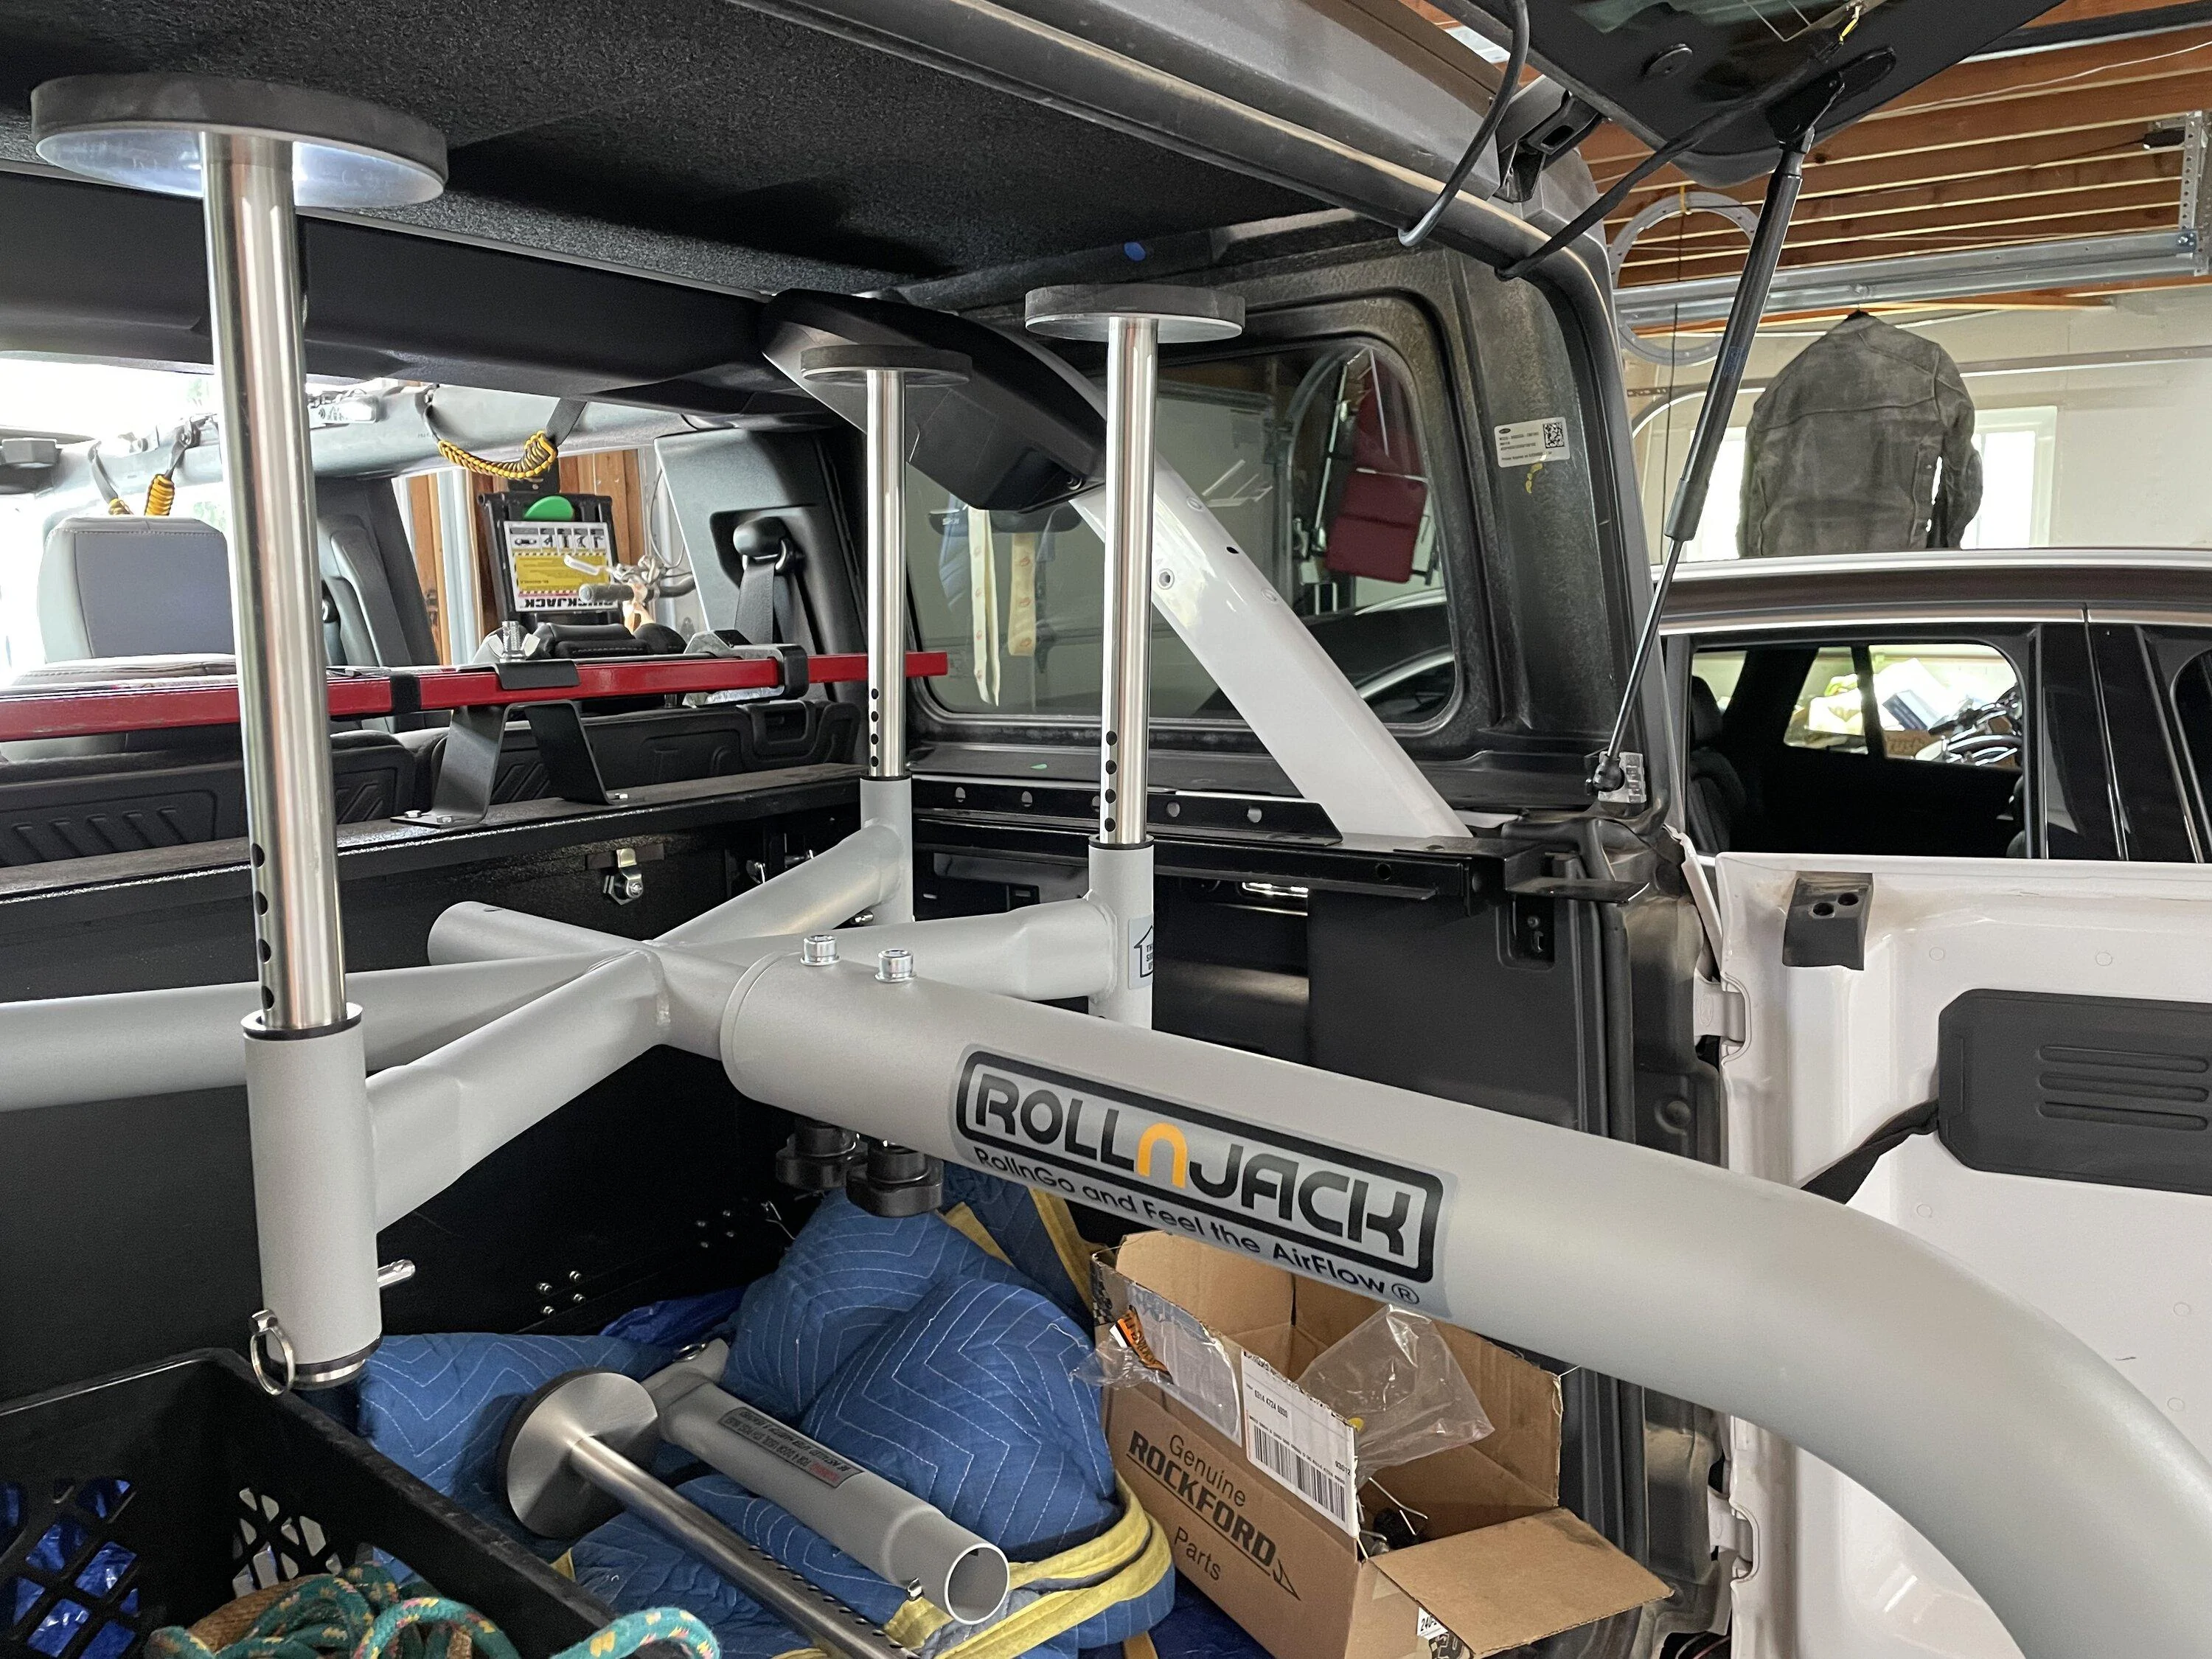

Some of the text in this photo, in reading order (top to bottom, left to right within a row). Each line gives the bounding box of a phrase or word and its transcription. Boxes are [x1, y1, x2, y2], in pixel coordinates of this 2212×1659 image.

[974, 1147, 1076, 1193] RollnGo
[1082, 1185, 1138, 1214] and
[1143, 1200, 1205, 1236] Feel
[1210, 1222, 1260, 1253] the
[1273, 1242, 1385, 1293] AirFlow
[1128, 1430, 1277, 1567] ROCKFORD
[1169, 1435, 1246, 1507] Genuine
[1174, 1526, 1222, 1582] Parts
